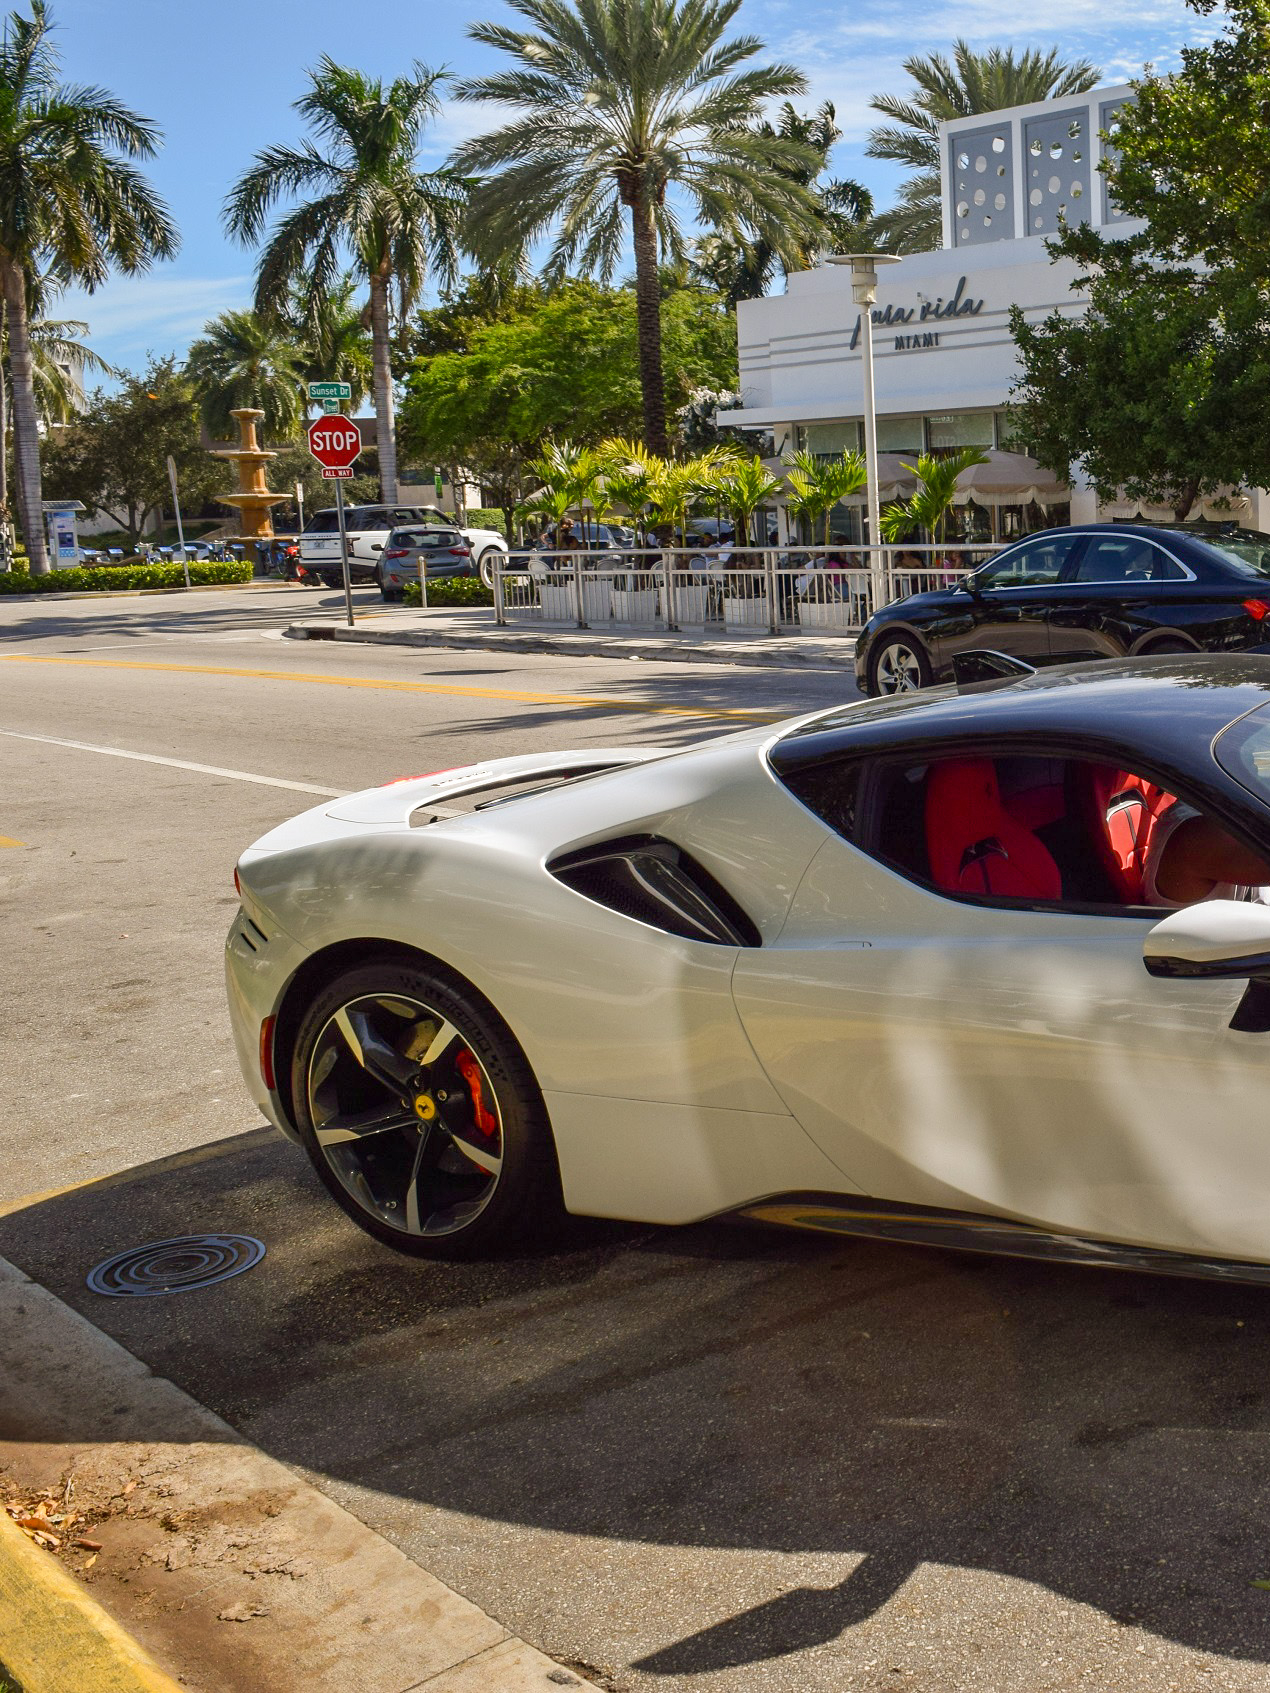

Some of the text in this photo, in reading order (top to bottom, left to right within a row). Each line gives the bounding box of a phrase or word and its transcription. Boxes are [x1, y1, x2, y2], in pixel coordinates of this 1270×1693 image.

[919, 276, 983, 321] vida
[895, 332, 940, 350] MIAMI
[311, 386, 348, 395] Sunset Dr
[312, 431, 357, 451] STOP
